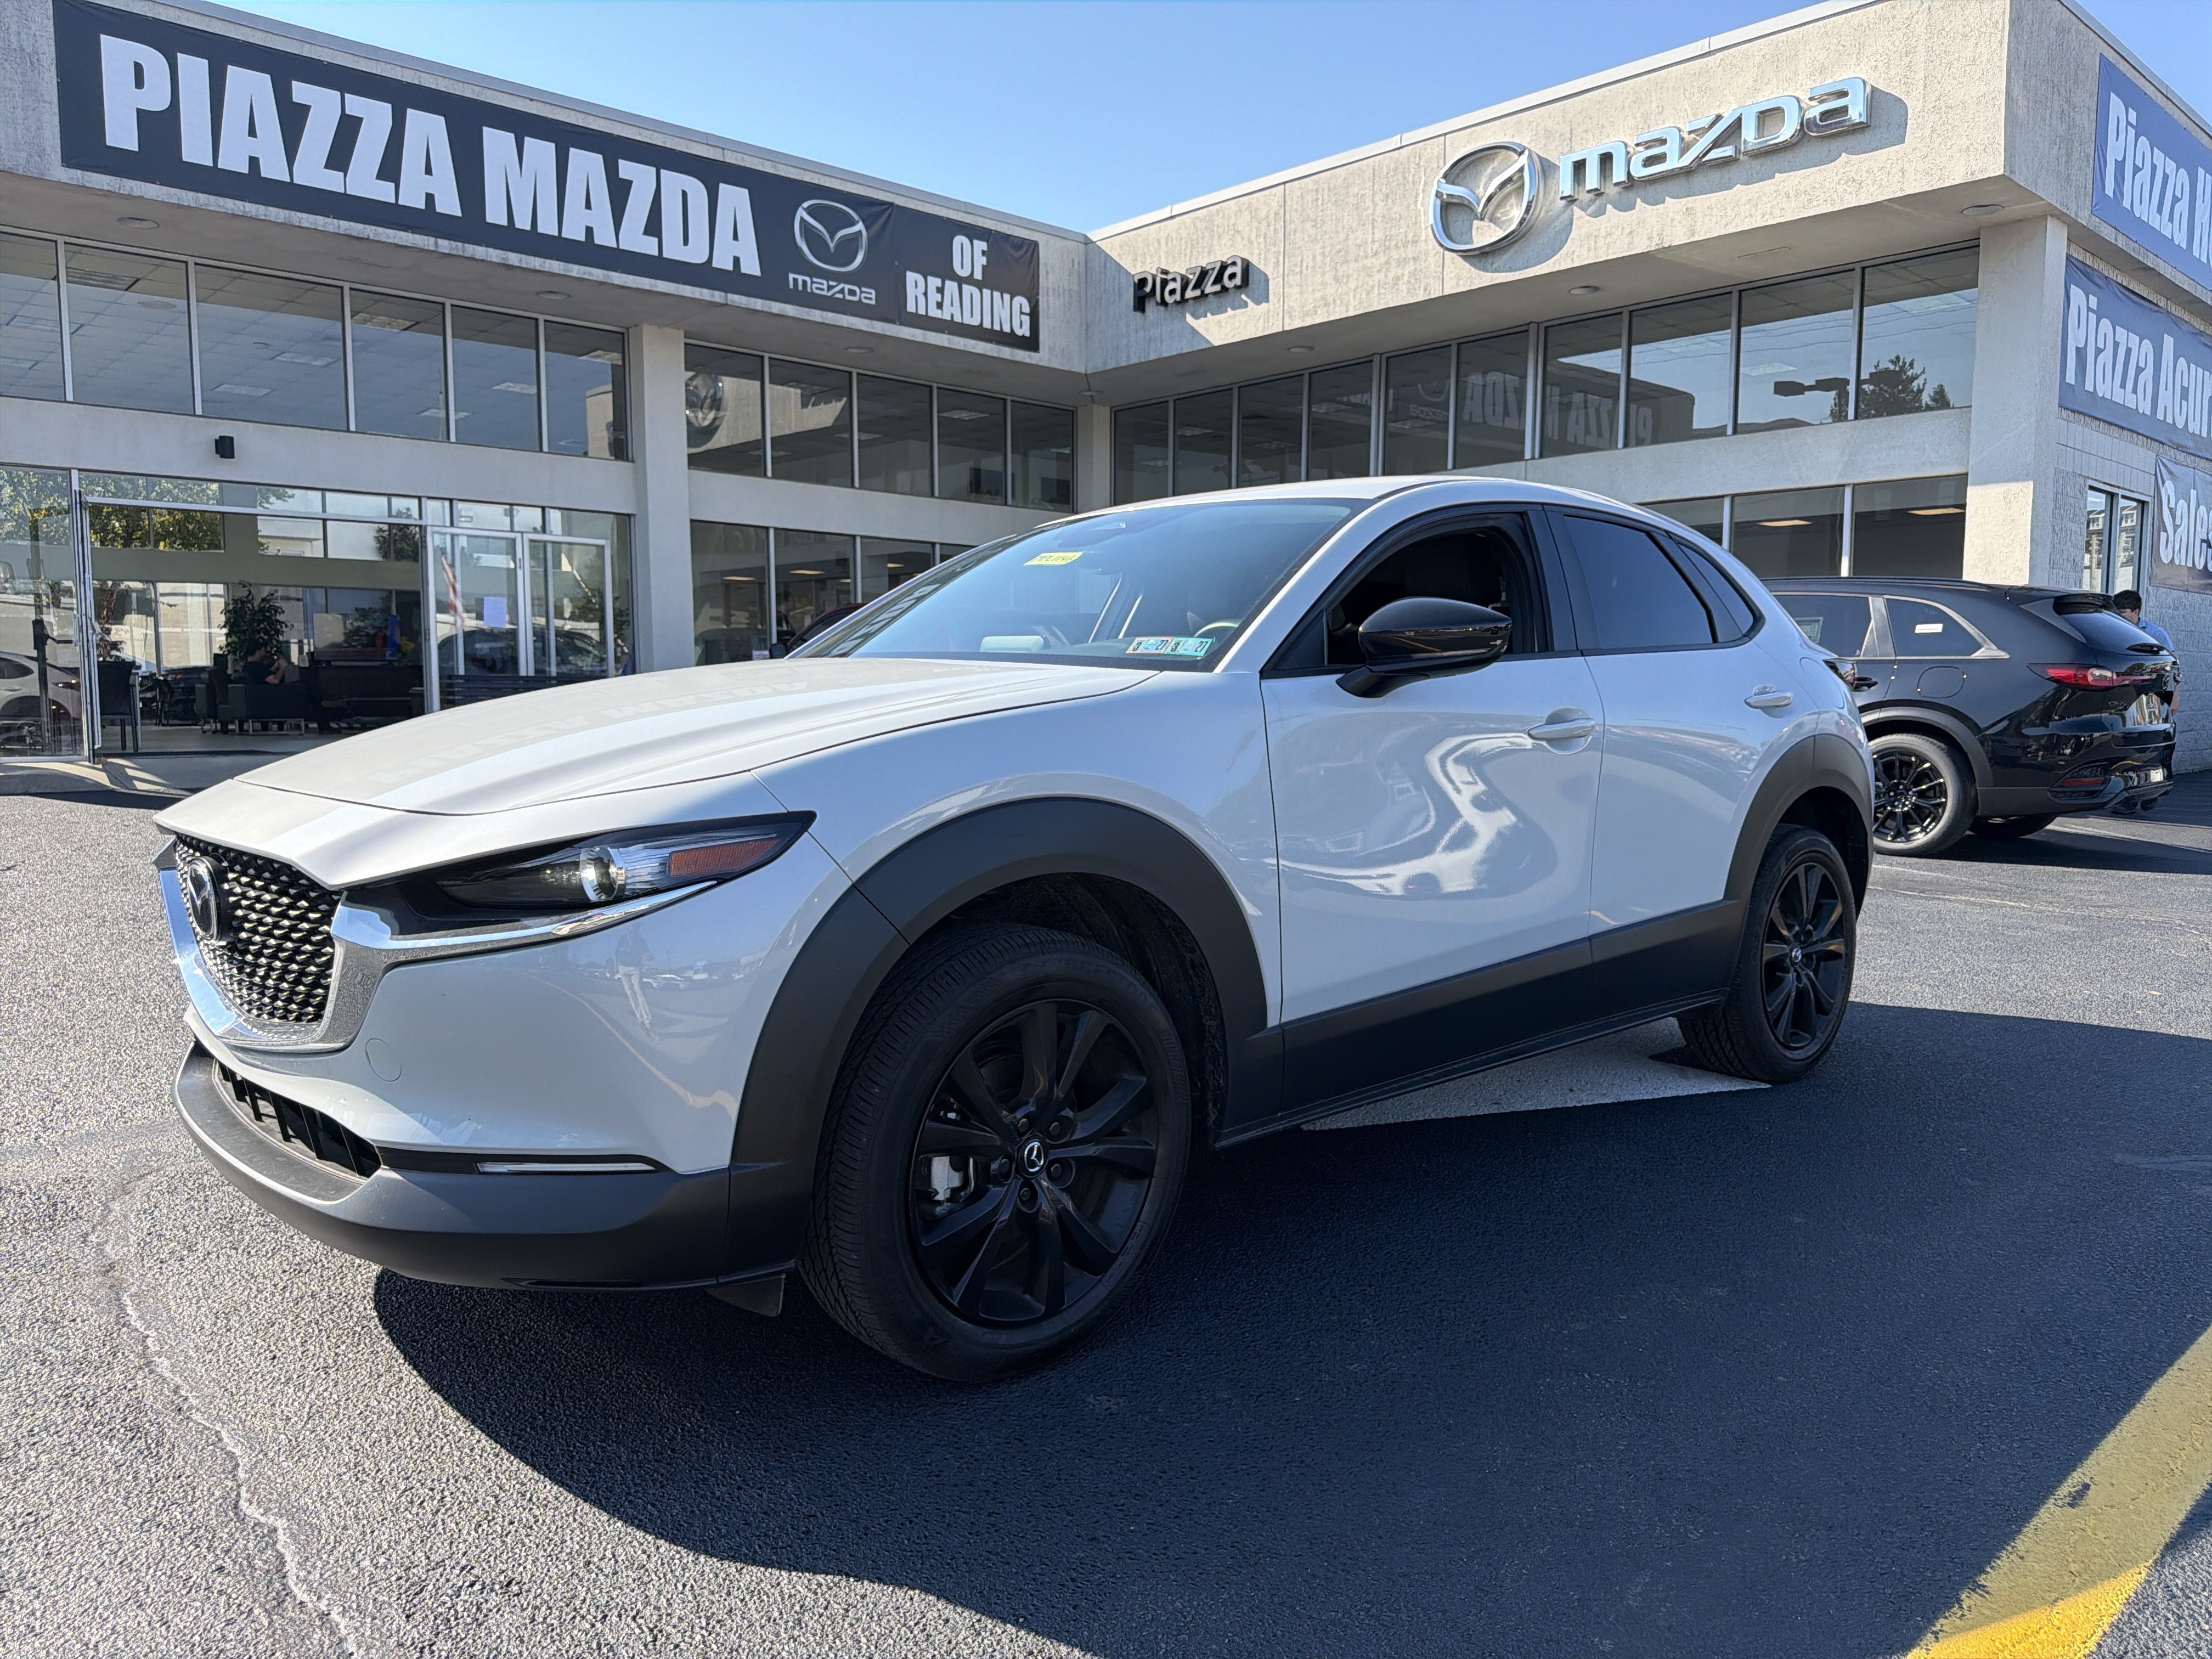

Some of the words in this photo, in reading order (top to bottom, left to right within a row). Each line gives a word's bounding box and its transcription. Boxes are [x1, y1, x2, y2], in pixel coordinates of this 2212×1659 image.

[100, 33, 462, 217] PIAZZA
[482, 126, 761, 276] MAZDA
[2105, 91, 2190, 250] Piazza
[952, 235, 987, 280] OF
[1133, 255, 1249, 313] Piazza
[906, 270, 1030, 337] READING
[2065, 284, 2154, 416] Piazza
[2157, 334, 2212, 438] Acur
[1155, 639, 1169, 651] 27
[1194, 641, 1209, 652] 27
